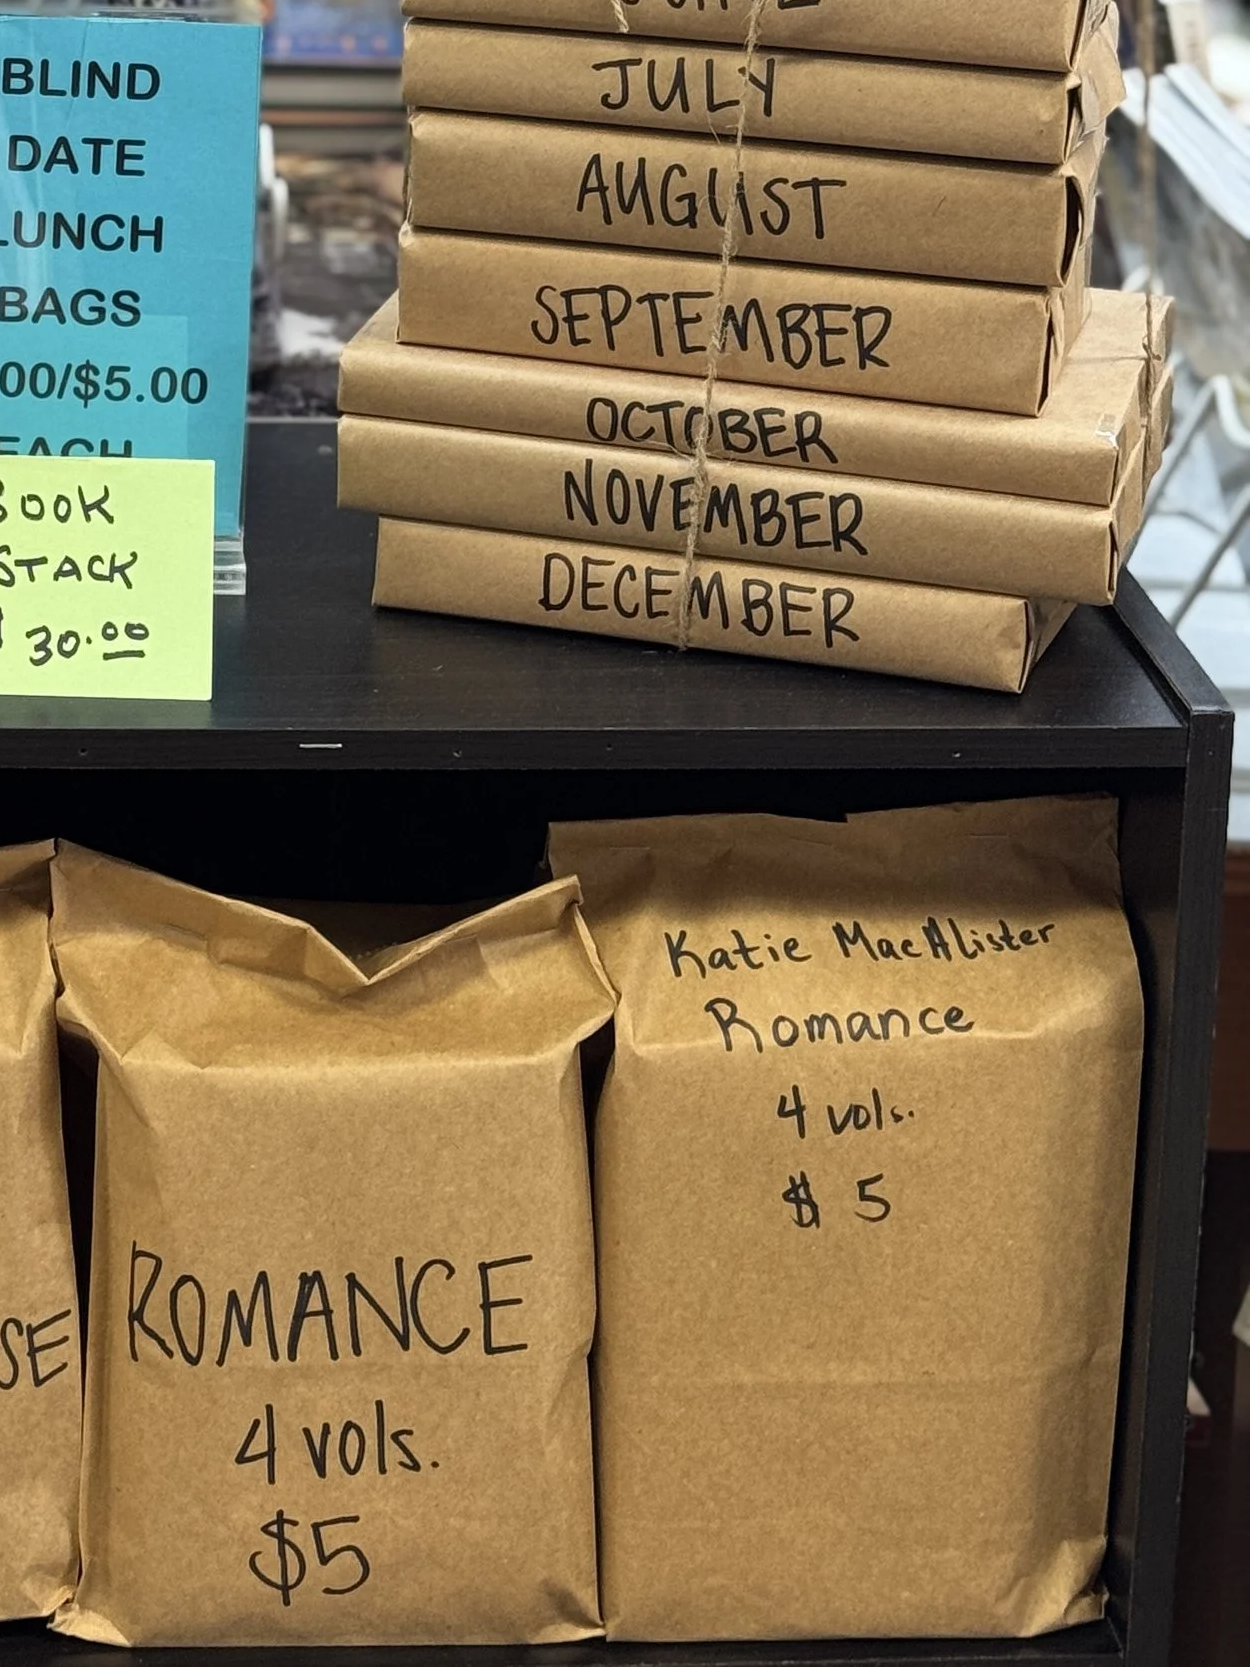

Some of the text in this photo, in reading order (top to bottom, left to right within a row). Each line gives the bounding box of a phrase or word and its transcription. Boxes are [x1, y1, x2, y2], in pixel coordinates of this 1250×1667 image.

[0, 57, 161, 101] BLIND
[591, 56, 776, 117] JULY
[7, 134, 147, 177] DATE
[576, 153, 847, 239] AUGUST
[531, 285, 892, 370] SEPTEMBER
[586, 397, 839, 463] OCTOBER
[564, 458, 868, 556] NOVEMBER
[538, 552, 860, 648] DECEMBER
[663, 927, 812, 980] Katie
[704, 996, 975, 1054] Romance
[776, 1084, 915, 1139] 4 vols.
[128, 1239, 533, 1366] ROMANCE
[234, 1399, 440, 1485] 4 vols.
[248, 1508, 370, 1606] $5
